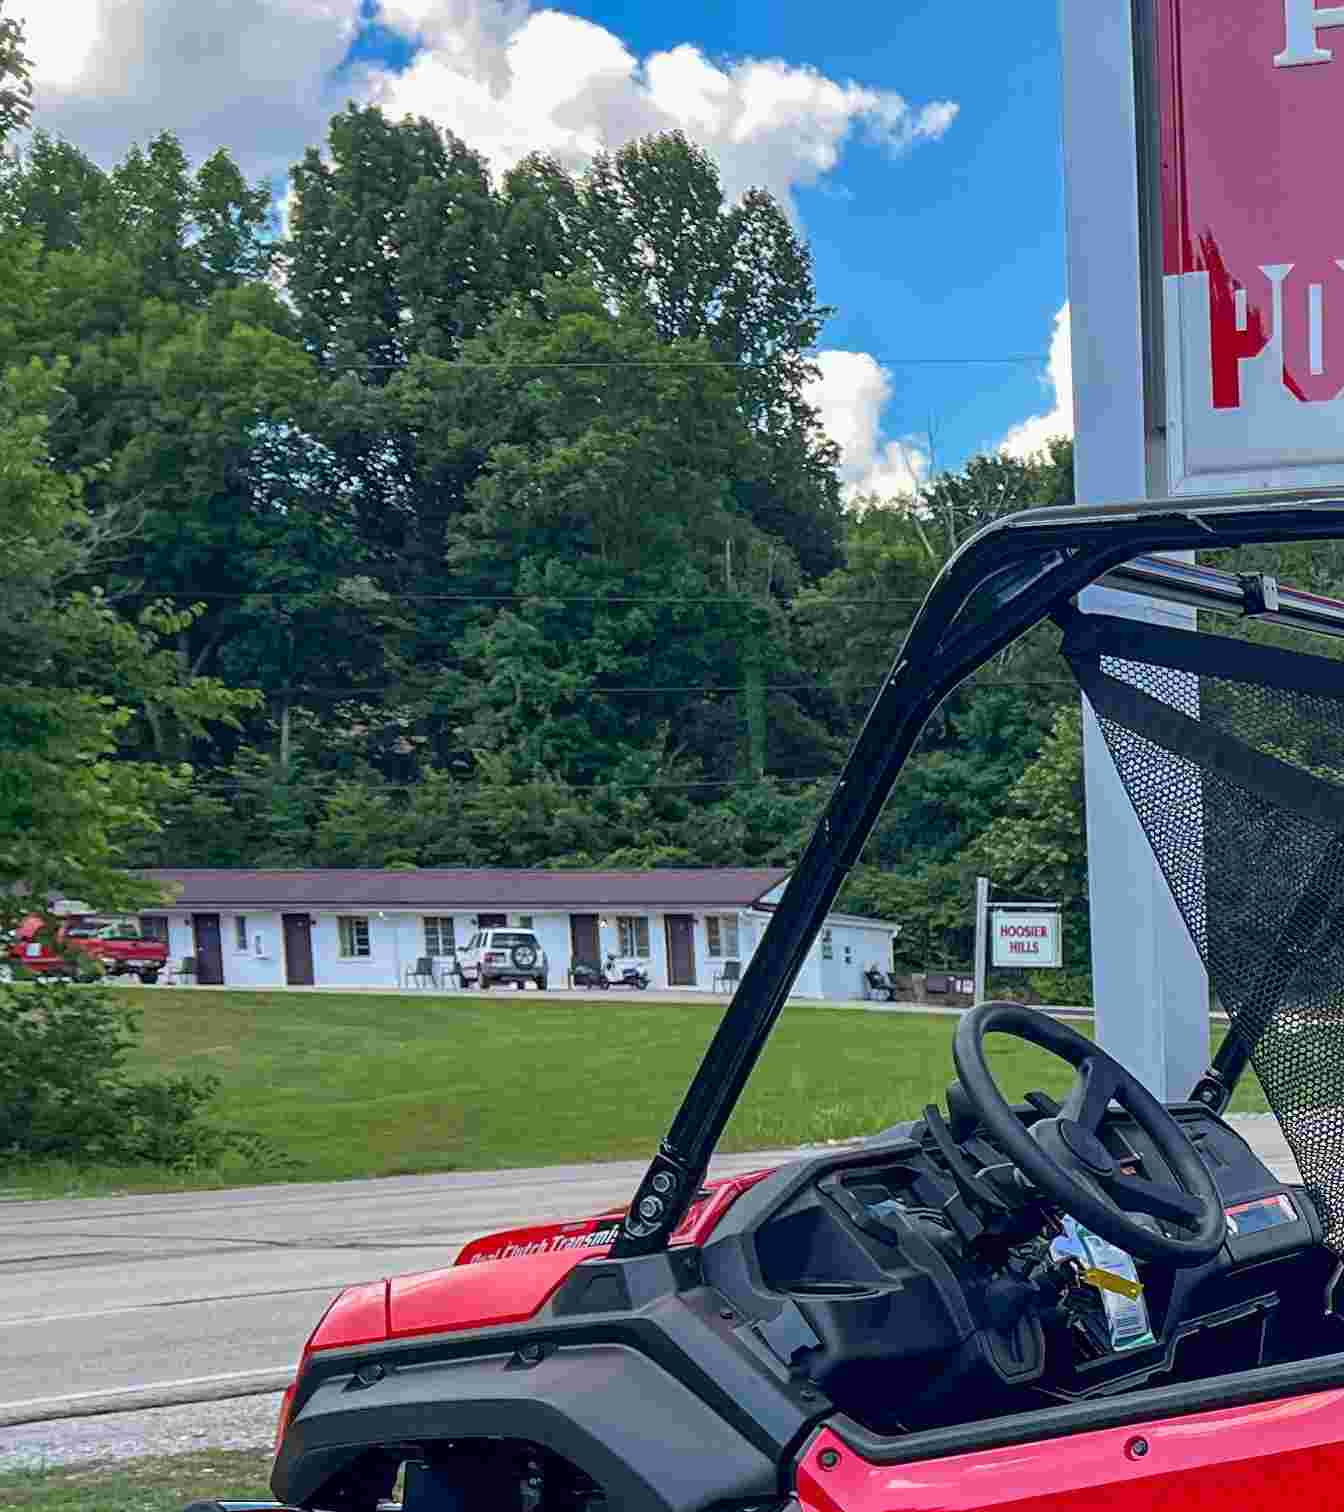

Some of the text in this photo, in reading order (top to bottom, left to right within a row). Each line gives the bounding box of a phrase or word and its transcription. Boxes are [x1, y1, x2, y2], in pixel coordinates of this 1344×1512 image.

[1000, 925, 1048, 937] HOOSIER
[1009, 941, 1040, 954] HILLS
[550, 1223, 619, 1250] Transmi
